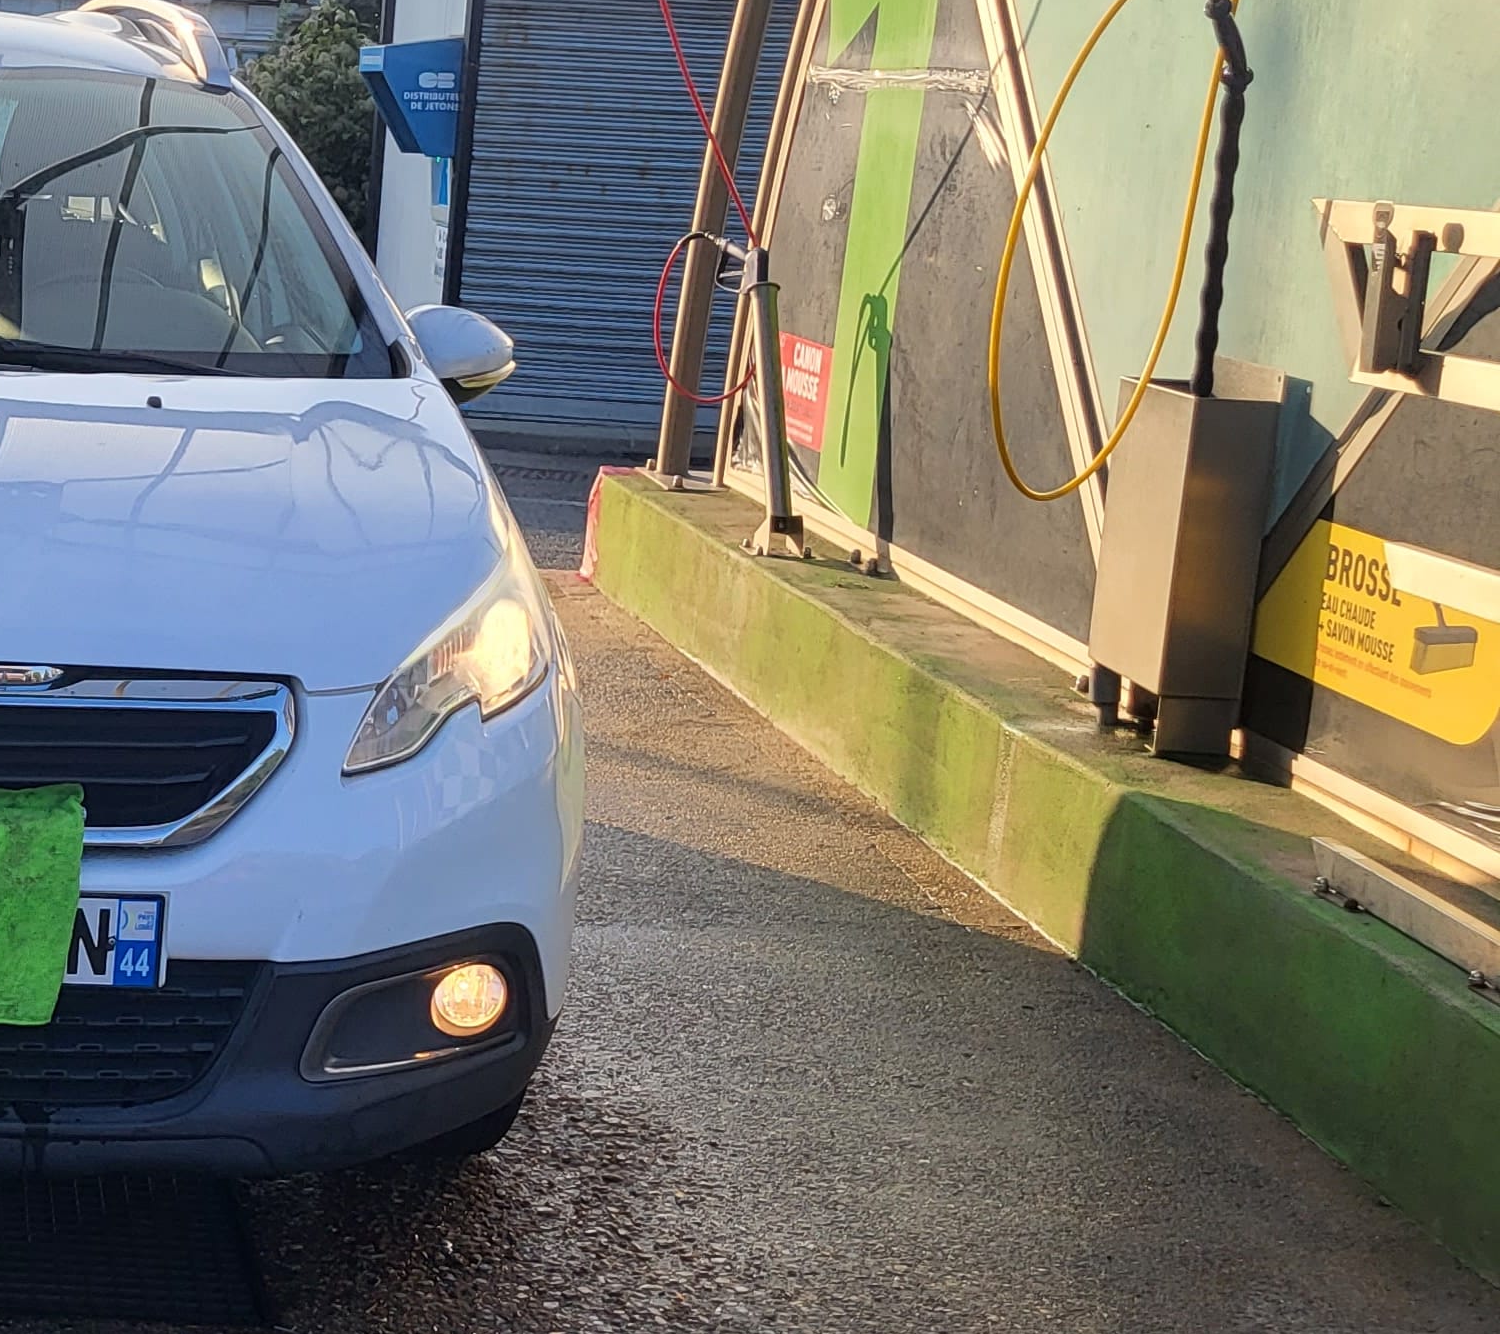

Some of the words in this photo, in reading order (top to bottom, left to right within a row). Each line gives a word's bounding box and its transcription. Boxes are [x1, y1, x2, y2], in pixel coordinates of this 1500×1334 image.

[410, 101, 422, 111] DE
[793, 341, 823, 375] CANON
[785, 366, 820, 403] MOUSSE
[1320, 591, 1338, 615] EAU
[1339, 599, 1377, 630] CHAUDE
[1326, 619, 1355, 648] SAVON
[1356, 632, 1395, 664] MOUSSE
[120, 947, 150, 977] 44
